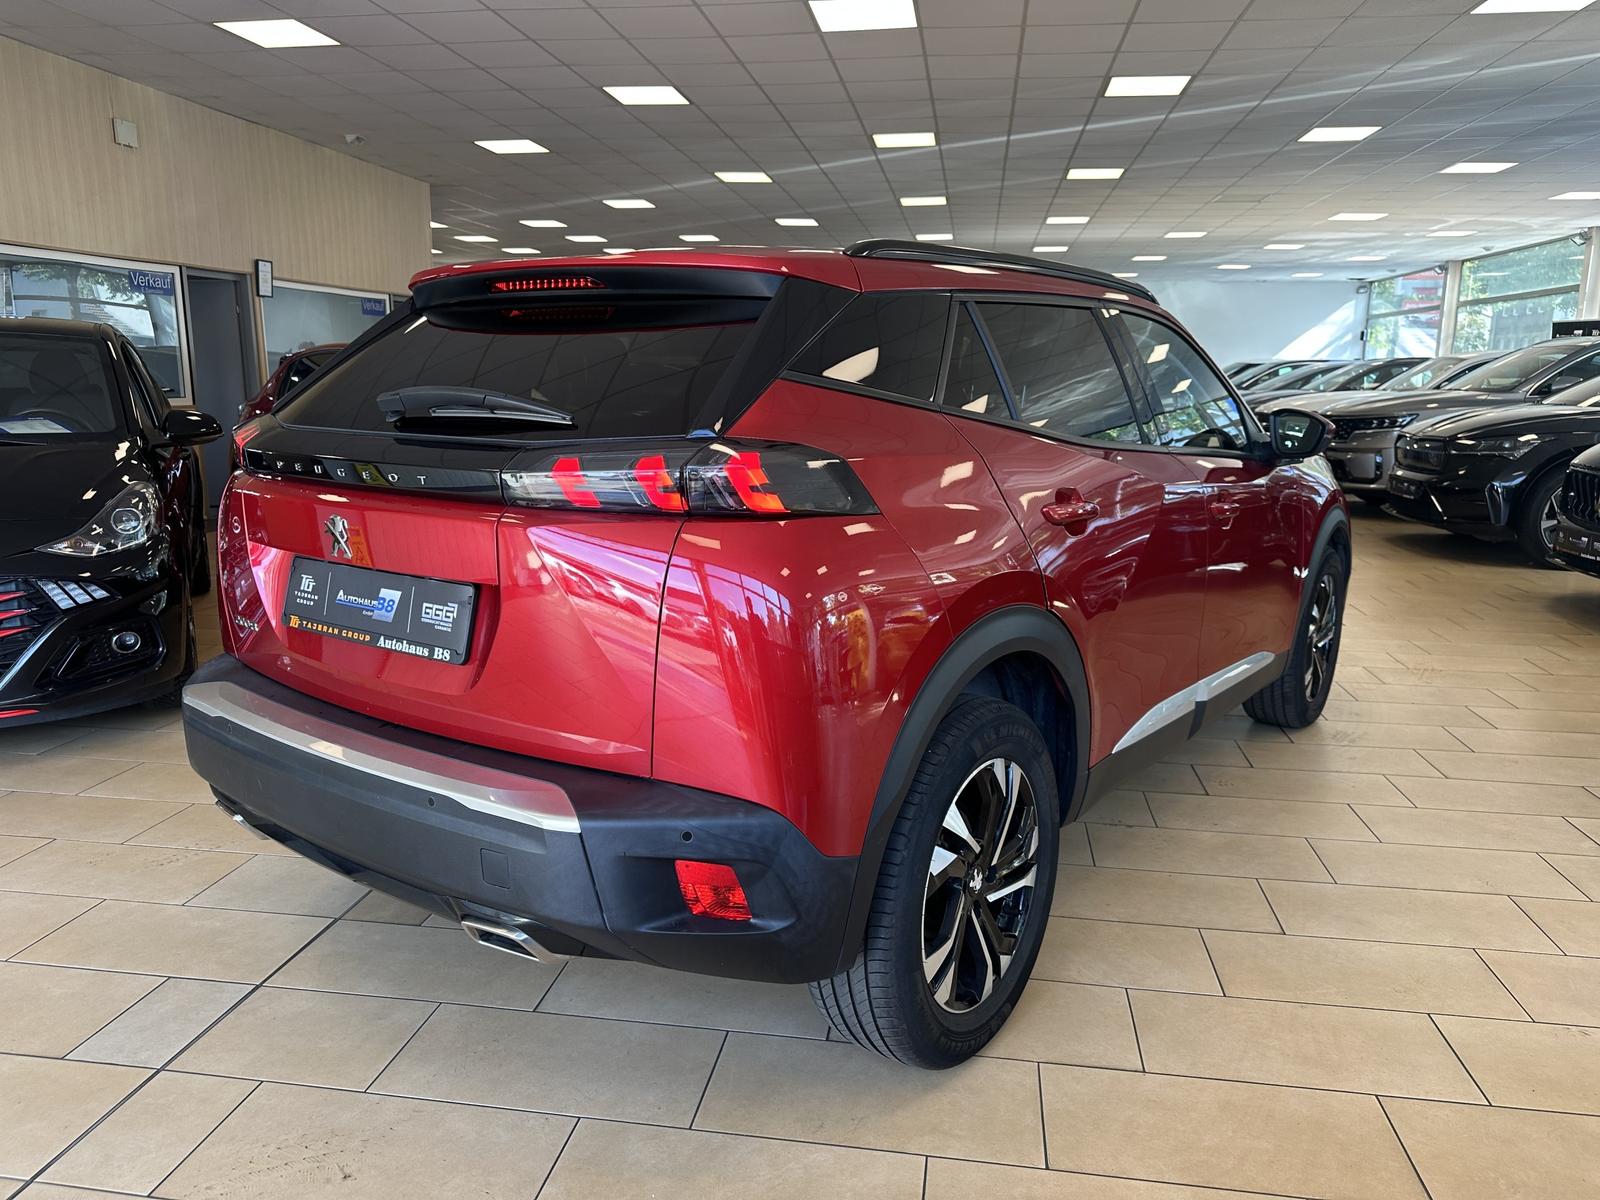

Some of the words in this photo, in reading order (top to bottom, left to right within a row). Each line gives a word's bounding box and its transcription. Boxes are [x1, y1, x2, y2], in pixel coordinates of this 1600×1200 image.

[130, 271, 171, 289] Verkauf
[276, 460, 427, 486] PEUGEOT
[341, 629, 371, 642] GROUP
[377, 635, 430, 657] Autohaus
[433, 646, 451, 661] B8
